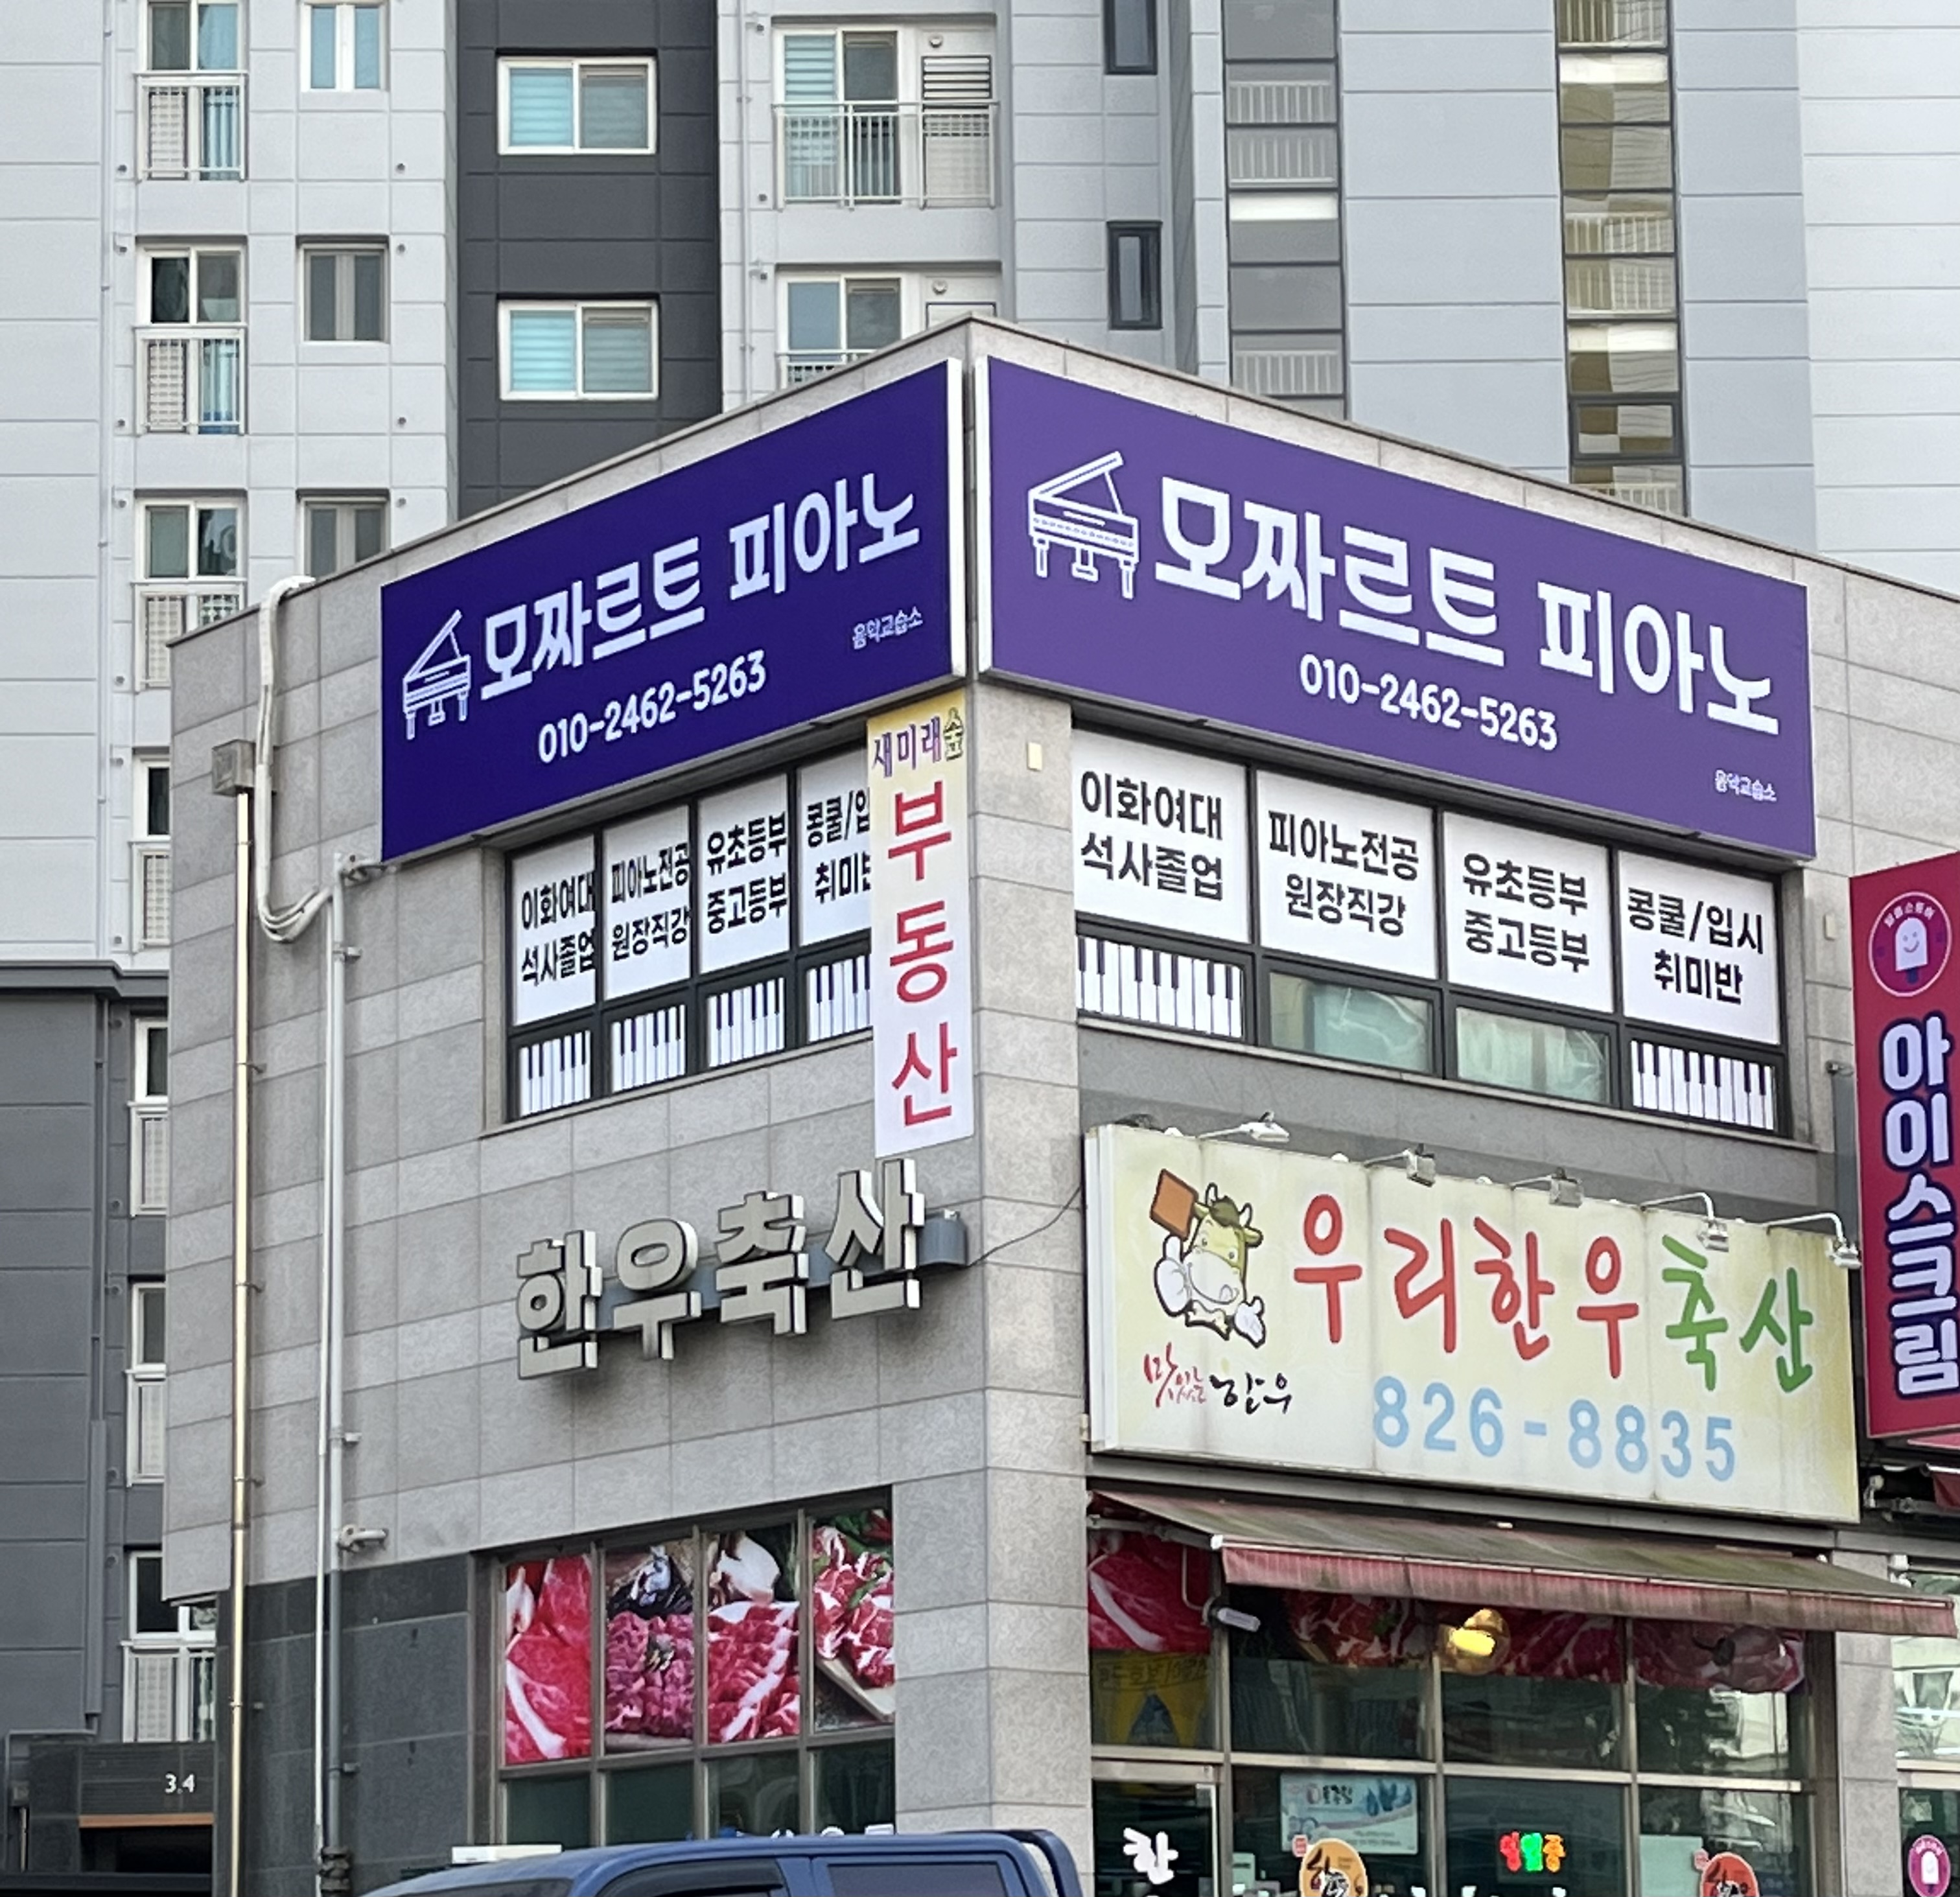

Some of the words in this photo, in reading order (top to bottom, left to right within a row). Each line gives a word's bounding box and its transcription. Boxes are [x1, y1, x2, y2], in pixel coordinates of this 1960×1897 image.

[482, 537, 705, 700] 모짜르트
[729, 473, 919, 600] 피아노
[1155, 476, 1504, 667] 모짜르트
[1537, 582, 1779, 735] 피아노
[539, 650, 765, 763] 010-2462-5263
[1300, 653, 1558, 751] 010-2462-5263
[1081, 771, 1222, 840] 이화여대
[612, 843, 689, 903] 피아노전공
[707, 811, 787, 876] 유초등부
[1080, 833, 1222, 901] 석사졸업
[1268, 811, 1419, 881] 피아노전공
[522, 871, 595, 930] 이화여대
[707, 872, 787, 934] 중고등부
[1285, 874, 1405, 936] 원장직강
[1463, 853, 1587, 915] 유초등부
[612, 905, 690, 961] 원장직강
[888, 781, 957, 1126] 부동산
[1464, 909, 1589, 973] 중고등부
[1628, 888, 1763, 955] 콩쿨/입시
[1654, 949, 1743, 1005] 취미반
[1882, 1016, 1959, 1395] 아이스크림
[517, 1158, 925, 1379] 한우축산
[1662, 1235, 1814, 1392] 축산
[1374, 1376, 1736, 1482] 826-8835
